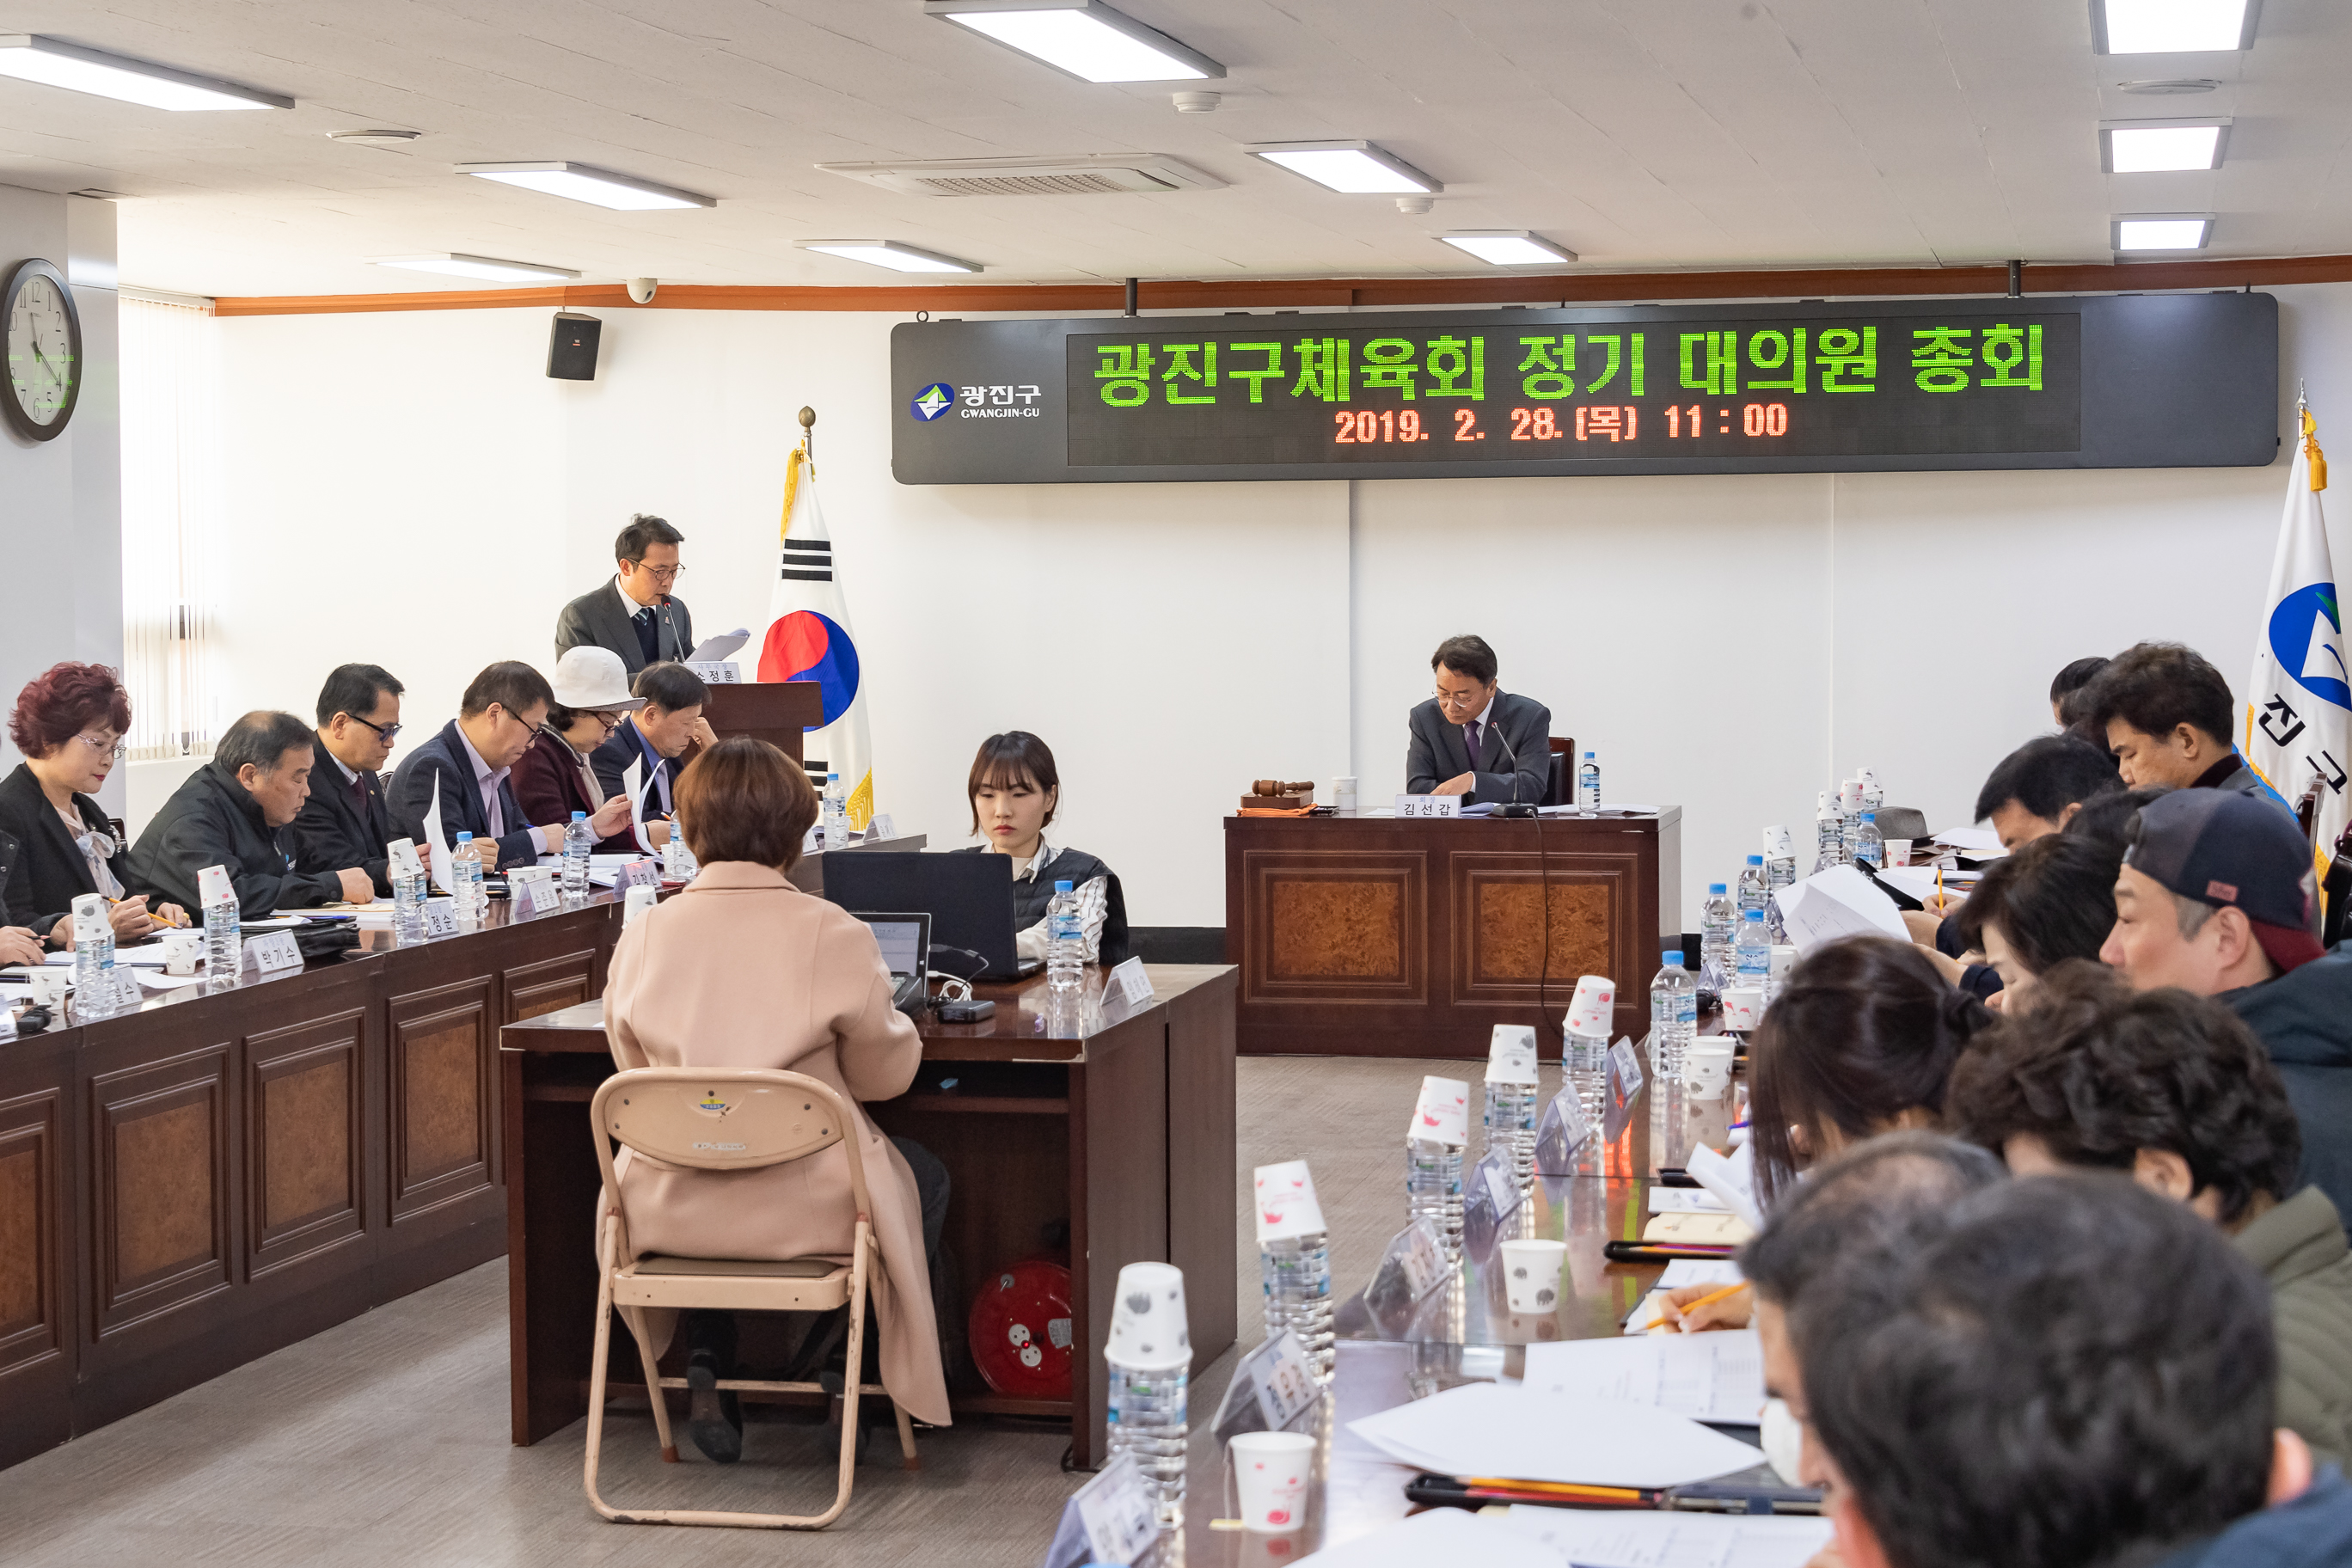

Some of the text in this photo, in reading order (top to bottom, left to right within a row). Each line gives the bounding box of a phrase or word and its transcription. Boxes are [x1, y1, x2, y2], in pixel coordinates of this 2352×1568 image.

[31, 281, 41, 303] 12
[1094, 323, 2043, 407] 광진구체육회 정기 대의원 총회
[959, 385, 1042, 407] 광진구
[960, 407, 1040, 419] GWANGJIN-GU
[1335, 409, 1429, 443] 2019.
[1454, 408, 1485, 442] 2.
[1510, 407, 1563, 441] 28.
[1404, 804, 1451, 816] 김선갑
[429, 915, 453, 934] 정순
[260, 946, 296, 969] 박기수
